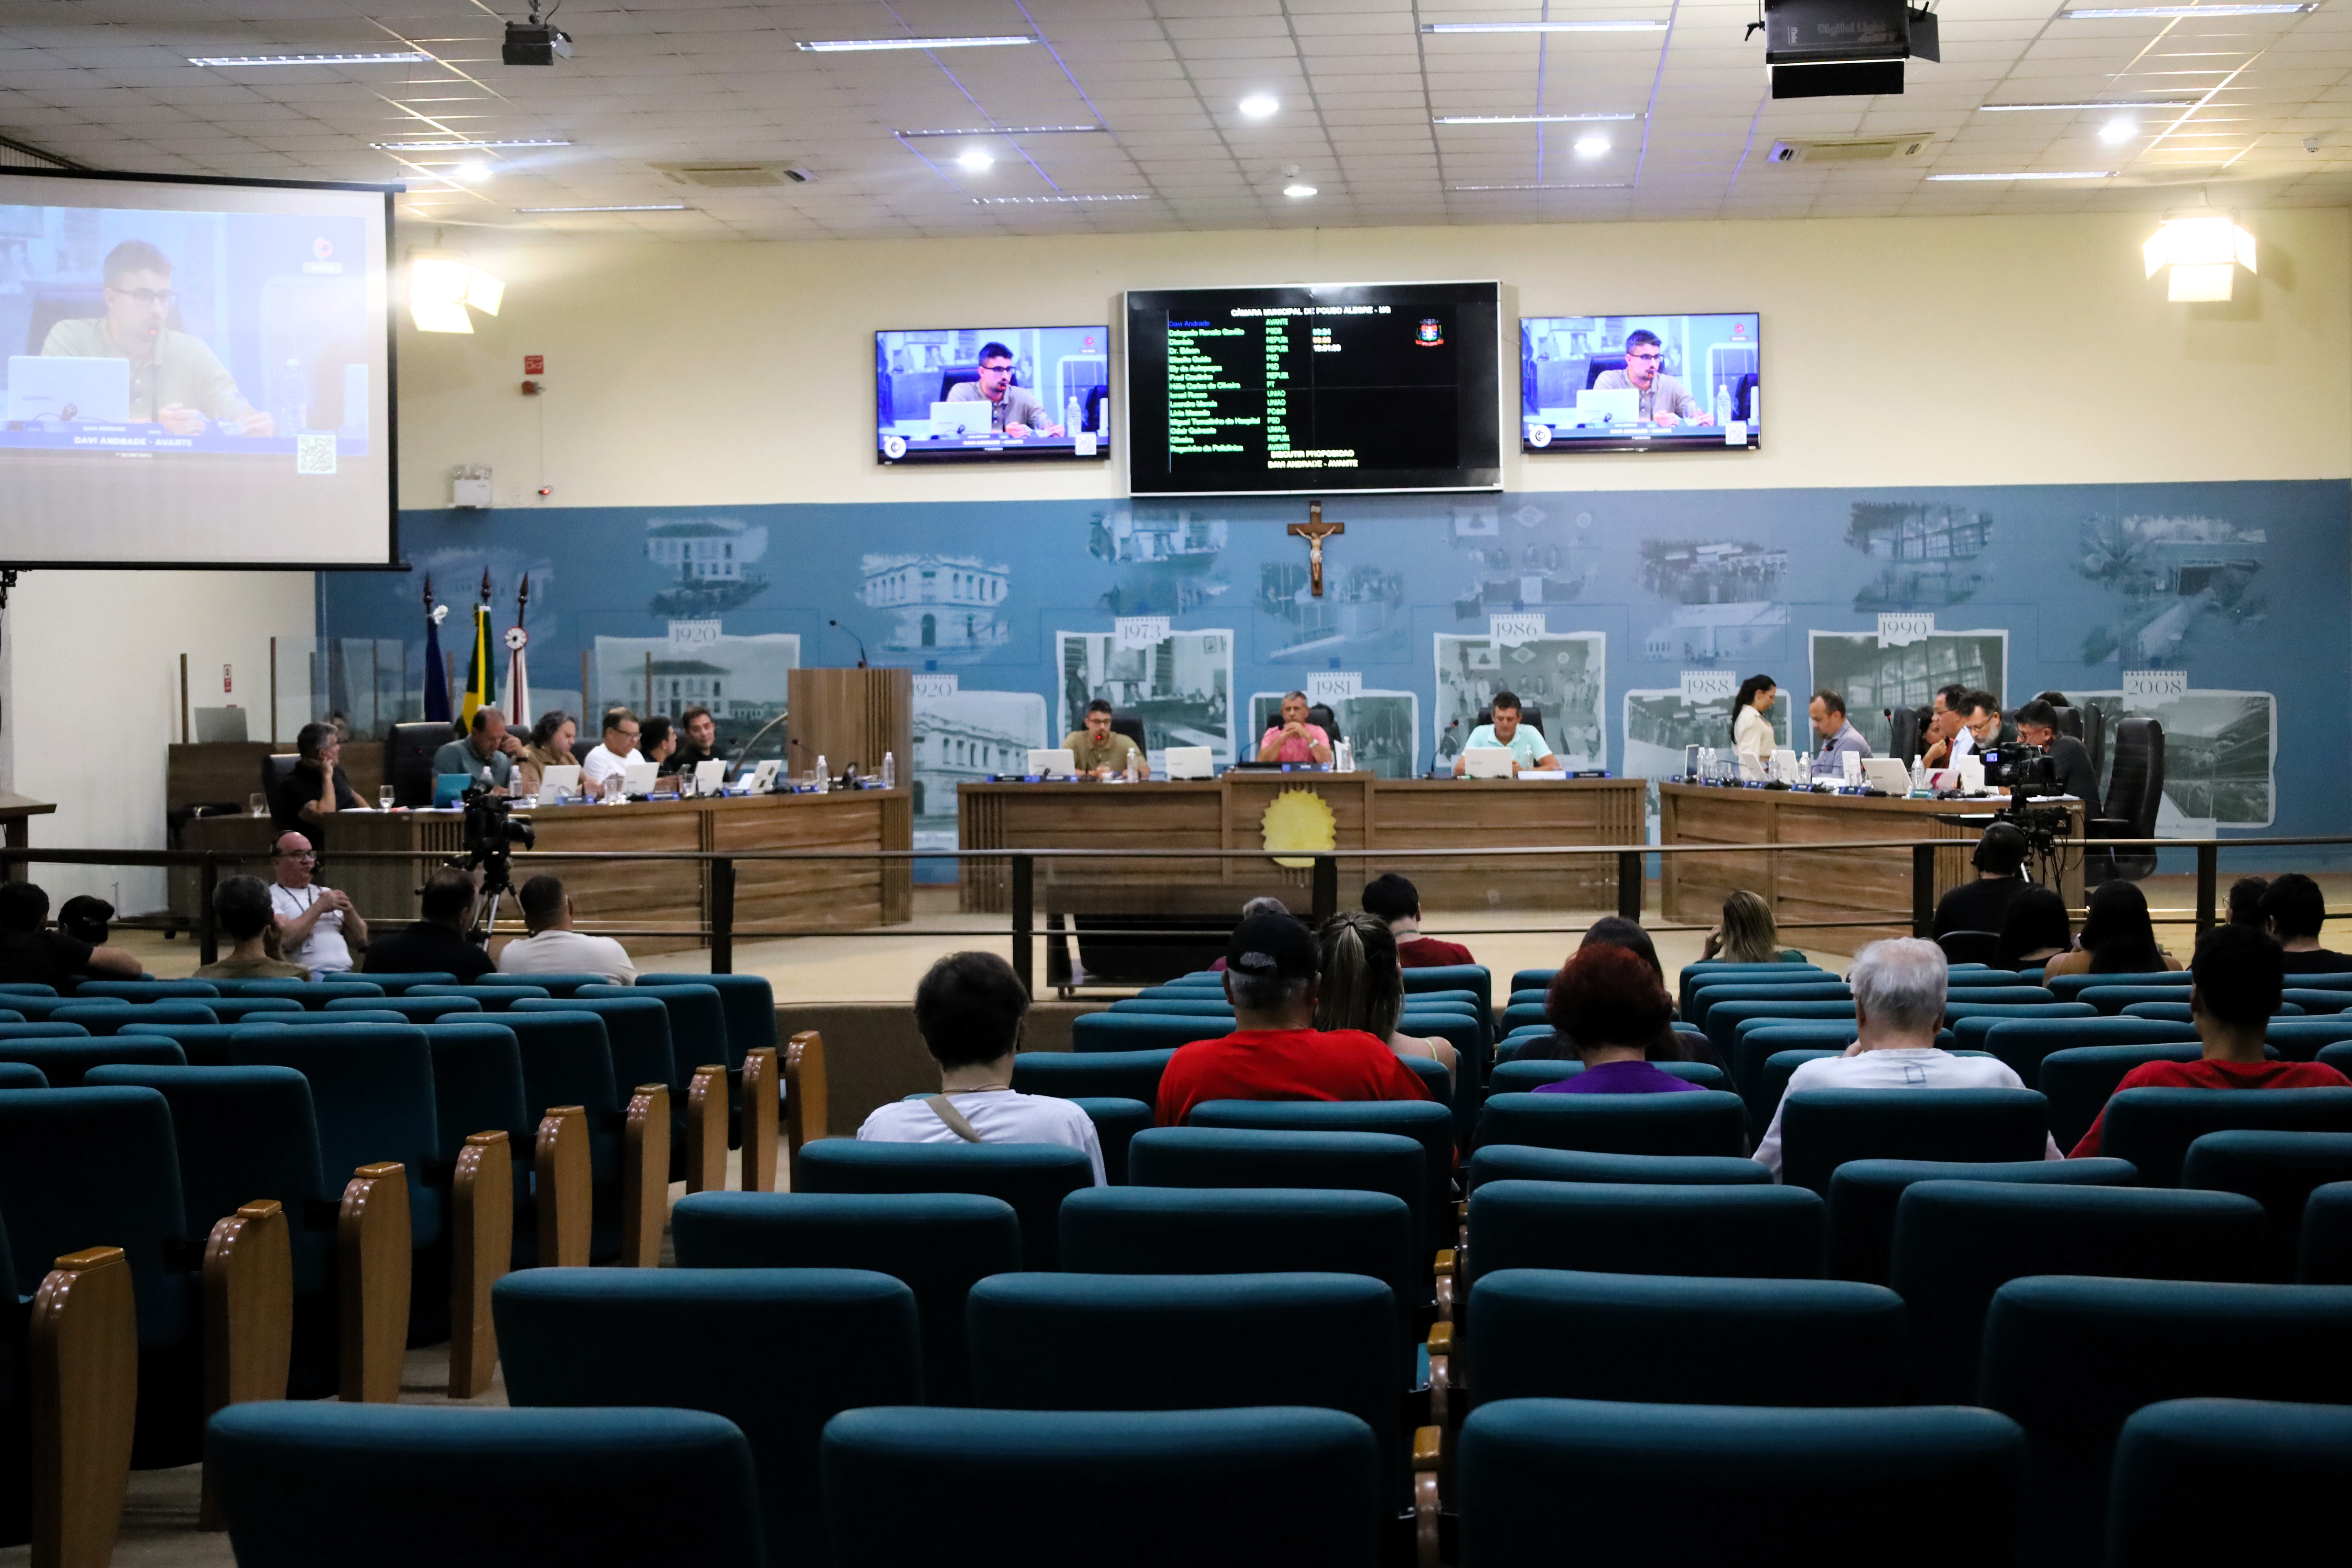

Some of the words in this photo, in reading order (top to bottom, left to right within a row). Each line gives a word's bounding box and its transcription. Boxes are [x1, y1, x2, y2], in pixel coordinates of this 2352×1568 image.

[1818, 22, 1854, 36] Digital
[1231, 308, 1262, 317] CÂMARA
[1263, 308, 1303, 316] MUNICIPAL
[74, 436, 98, 444] DAVI
[100, 437, 147, 446] ANDRADE
[155, 438, 193, 447] AVANTE
[1271, 450, 1305, 459] DISCUTIR
[1286, 460, 1323, 468] ANDRADE
[1328, 459, 1358, 467] AVANTE
[675, 628, 716, 642] 1920
[1124, 625, 1161, 640] 1973
[1496, 622, 1537, 637] 1986
[1883, 620, 1927, 635] 1990
[913, 682, 952, 697] 920
[1317, 680, 1351, 695] 1981
[1688, 679, 1729, 694] 1988
[2128, 680, 2182, 695] 2008
